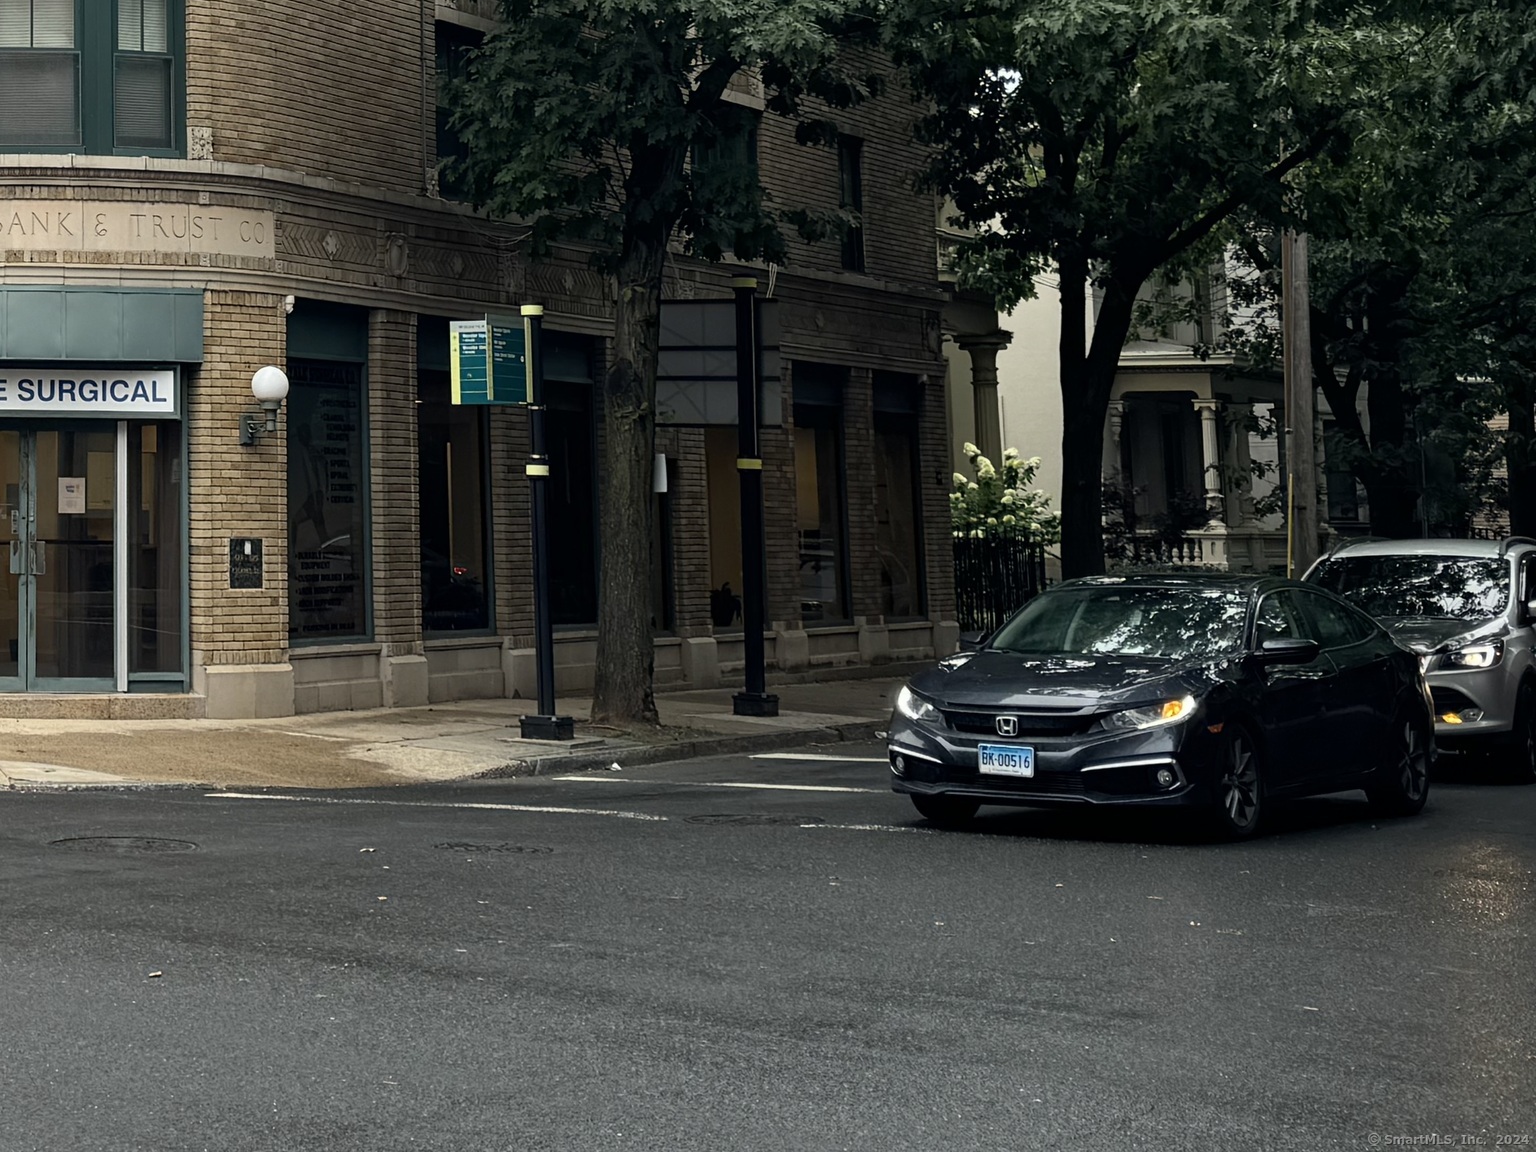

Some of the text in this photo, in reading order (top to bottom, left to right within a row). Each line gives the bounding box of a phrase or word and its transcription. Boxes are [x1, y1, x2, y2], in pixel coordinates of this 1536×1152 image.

[94, 213, 108, 237] &
[130, 213, 223, 240] TRUST
[17, 378, 168, 404] SURGICAL
